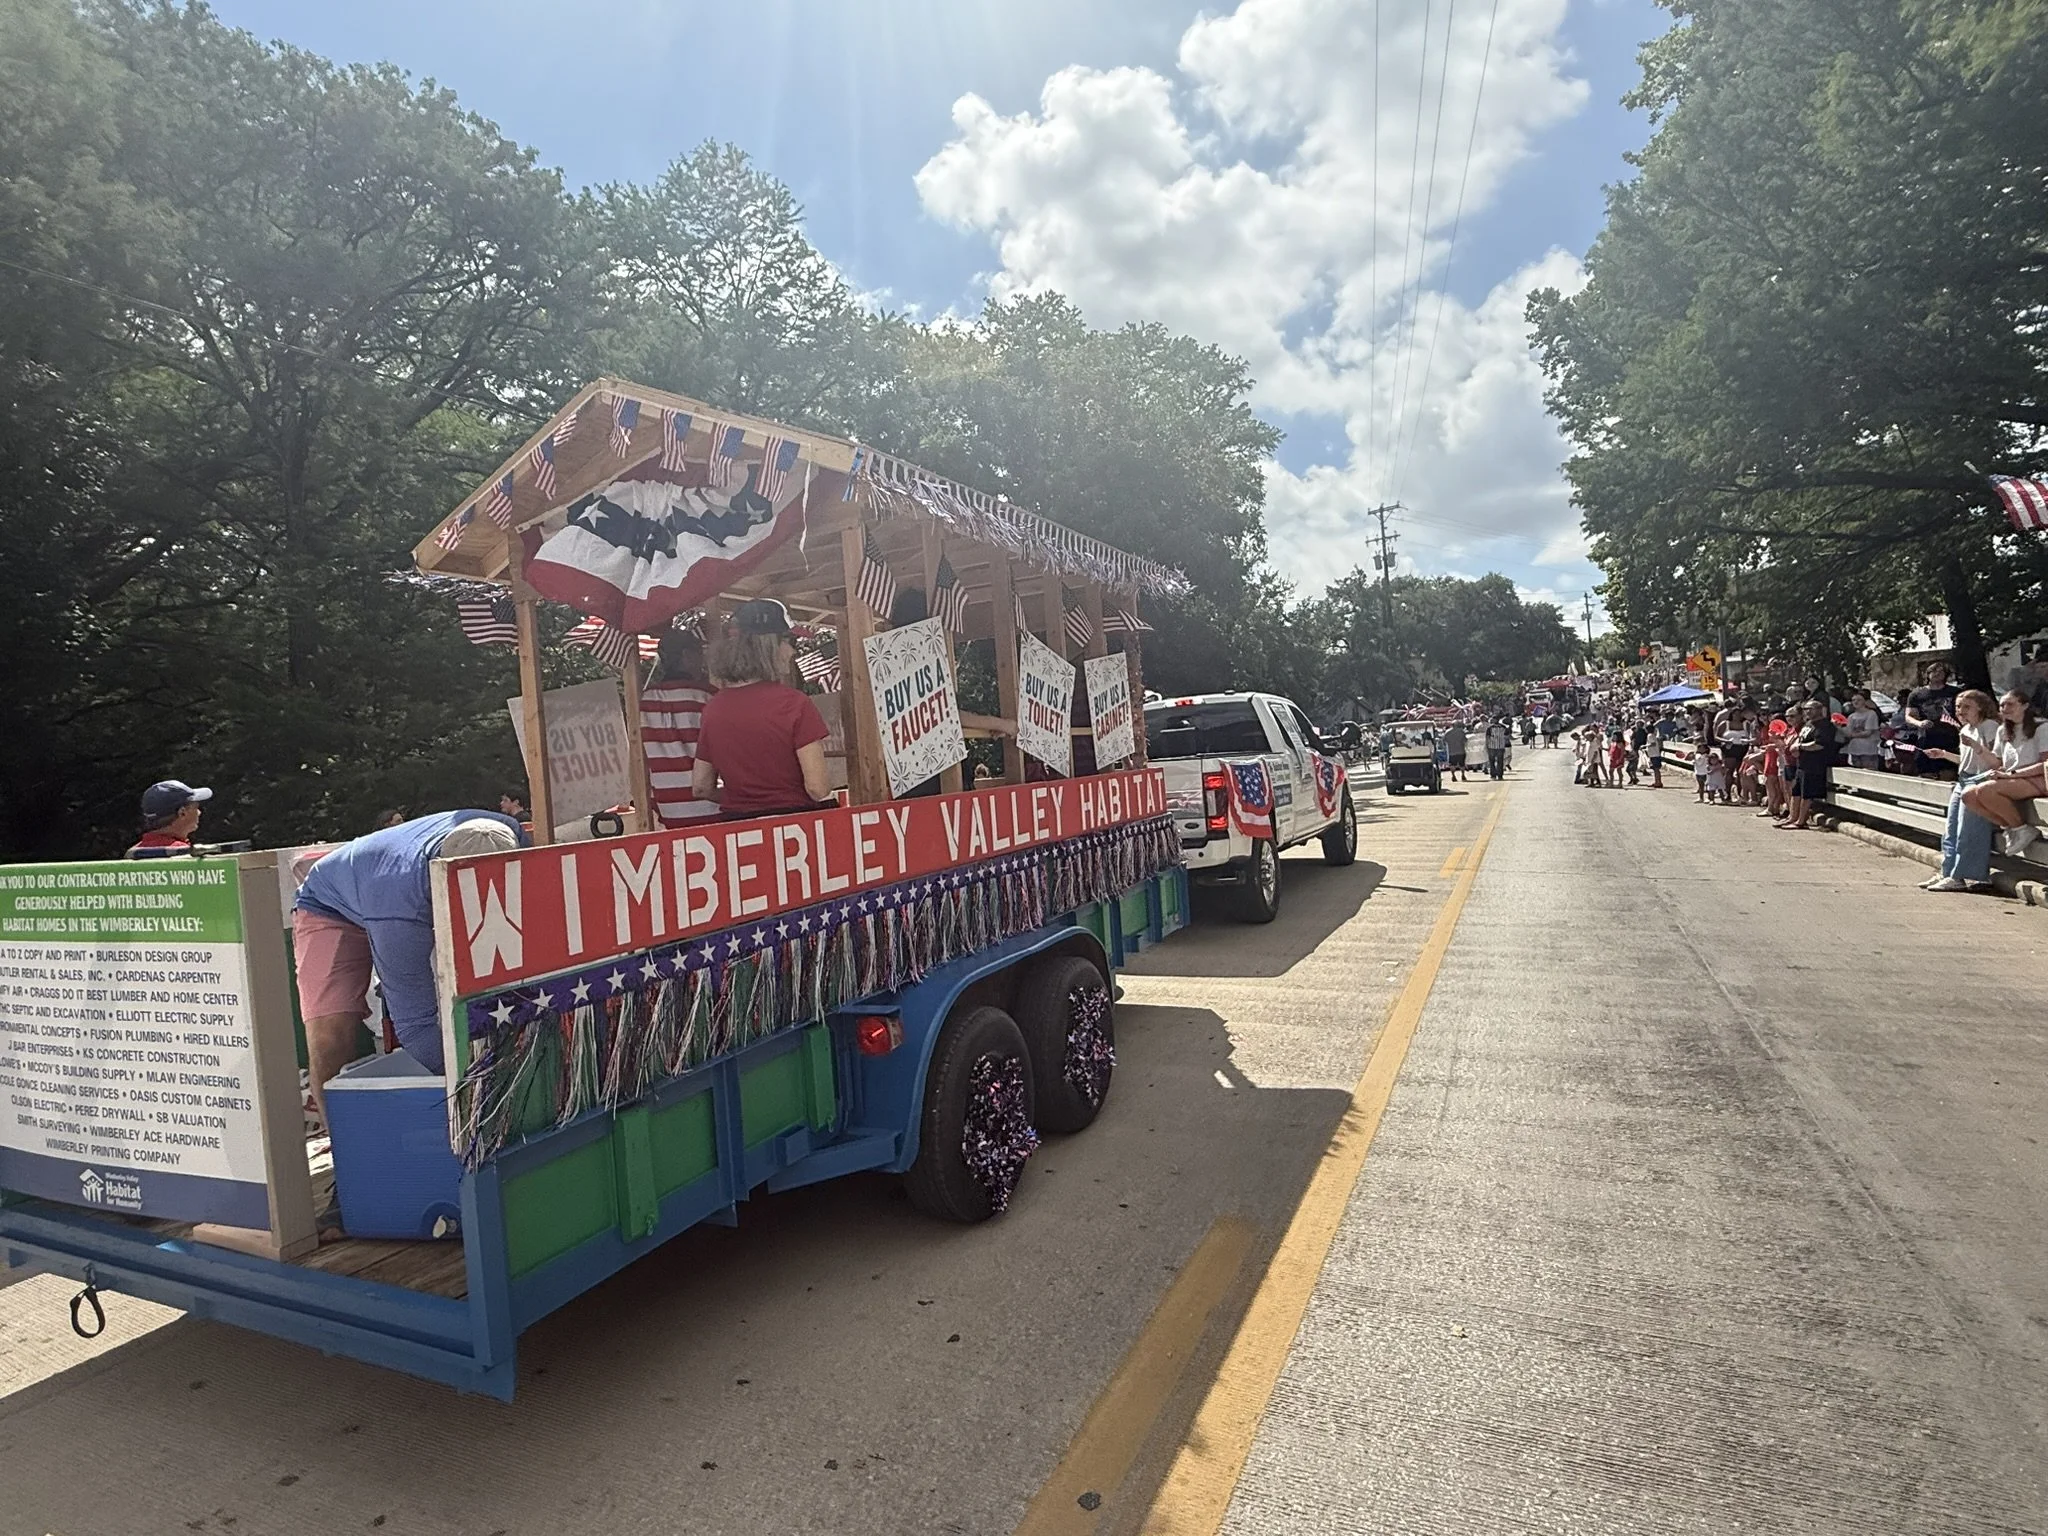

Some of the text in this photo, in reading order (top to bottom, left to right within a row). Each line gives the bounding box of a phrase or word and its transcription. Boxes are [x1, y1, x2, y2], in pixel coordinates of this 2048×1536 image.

[884, 658, 945, 720] BUY US A
[1703, 675, 1715, 684] 15
[1025, 672, 1067, 713] BUY US A
[1093, 680, 1126, 714] BUY US A
[891, 688, 950, 755] FAUCET!
[1027, 697, 1064, 738] TOILET!
[1095, 702, 1130, 742] CABINET!
[8, 875, 24, 889] YOU
[25, 875, 35, 888] TO
[37, 874, 56, 888] OUR
[57, 872, 117, 888] CONTRACTOR
[118, 870, 168, 887] PARTNERS
[169, 870, 195, 885] WHO
[197, 869, 226, 885] HAVE
[457, 771, 1165, 979] WIMBERLEY VALLEY HABITAT
[15, 893, 183, 910] GENEROUSLY HELPED WITH BUILDING
[3, 916, 204, 932] HABITAT HOMES IN THE WIMBERLEY VALLEY:
[1, 948, 212, 963] A TO Z COPY AND PRINT BURLESON DESIGN GROUP
[0, 966, 221, 984] UTLER RENTAL & SALES, INC. CARDENAS CARPENTRY
[12, 985, 23, 997] AIR
[30, 987, 60, 999] CRAGGS
[62, 988, 74, 1000] DO
[76, 989, 85, 1000] IT
[87, 989, 107, 1001] BEST
[110, 990, 147, 1002] LUMBER
[150, 991, 170, 1003] AND
[173, 992, 200, 1004] HOME
[203, 993, 239, 1006] CENTER
[12, 1004, 34, 1016] SEPTIC
[36, 1006, 51, 1017] AND
[53, 1007, 106, 1020] EXCAVATION
[116, 1009, 152, 1022] ELLIOTT
[155, 1011, 198, 1024] ELECTRIC
[200, 1013, 234, 1026] SUPPLY
[41, 1025, 81, 1039] CONCEPTS
[90, 1028, 122, 1041] FUSION
[126, 1030, 173, 1043] PLUMBING
[183, 1033, 210, 1045] HIRED
[213, 1035, 249, 1048] KILLERS
[27, 1042, 74, 1057] ENTERPRISES
[83, 1047, 94, 1059] KS
[97, 1048, 144, 1062] CONCRETE
[148, 1051, 220, 1067] CONSTRUCTION
[62, 1065, 99, 1079] BUILDING
[102, 1068, 136, 1081] SUPPLY
[146, 1071, 176, 1084] MLAW
[180, 1073, 240, 1089] ENGINEERING
[40, 1080, 77, 1096] CLEANING
[78, 1085, 120, 1100] SERVICES
[130, 1089, 158, 1102] OASIS
[161, 1092, 202, 1106] CUSTOM
[204, 1095, 252, 1111] CABINETS
[11, 1094, 227, 1129] OLSON ELECTRIC PEREZ DRYWALL SB VALUATION
[17, 1113, 221, 1149] SMITH SURVEYING WIMBERLEY ACE HARDWARE
[45, 1138, 181, 1165] WIMBERLEY PRINTING COMPANY
[106, 1180, 141, 1199] Habitat
